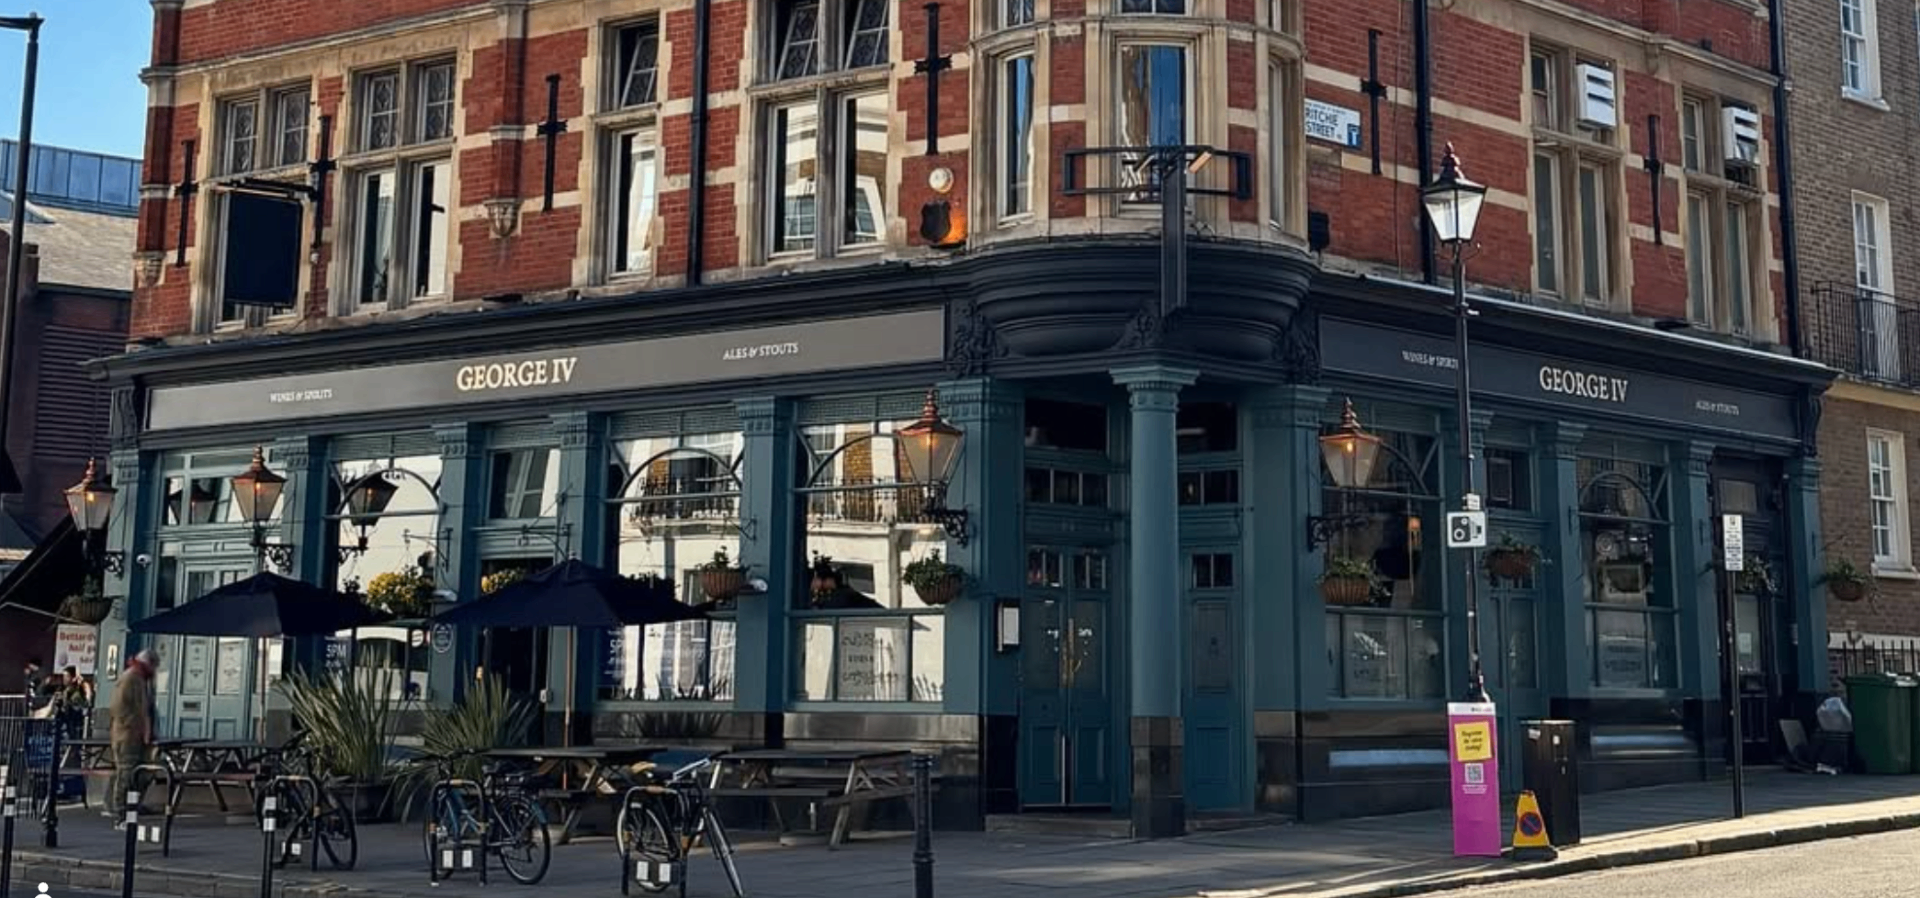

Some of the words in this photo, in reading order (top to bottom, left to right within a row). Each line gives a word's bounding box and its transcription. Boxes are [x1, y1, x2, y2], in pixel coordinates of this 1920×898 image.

[1306, 121, 1335, 139] STREET
[722, 347, 747, 360] ALES
[748, 345, 758, 358] &
[759, 341, 799, 357] STOUTS
[456, 359, 549, 391] GEORGE
[551, 357, 578, 384] IV
[1539, 365, 1610, 400] GEORGE
[1610, 378, 1629, 403] IV
